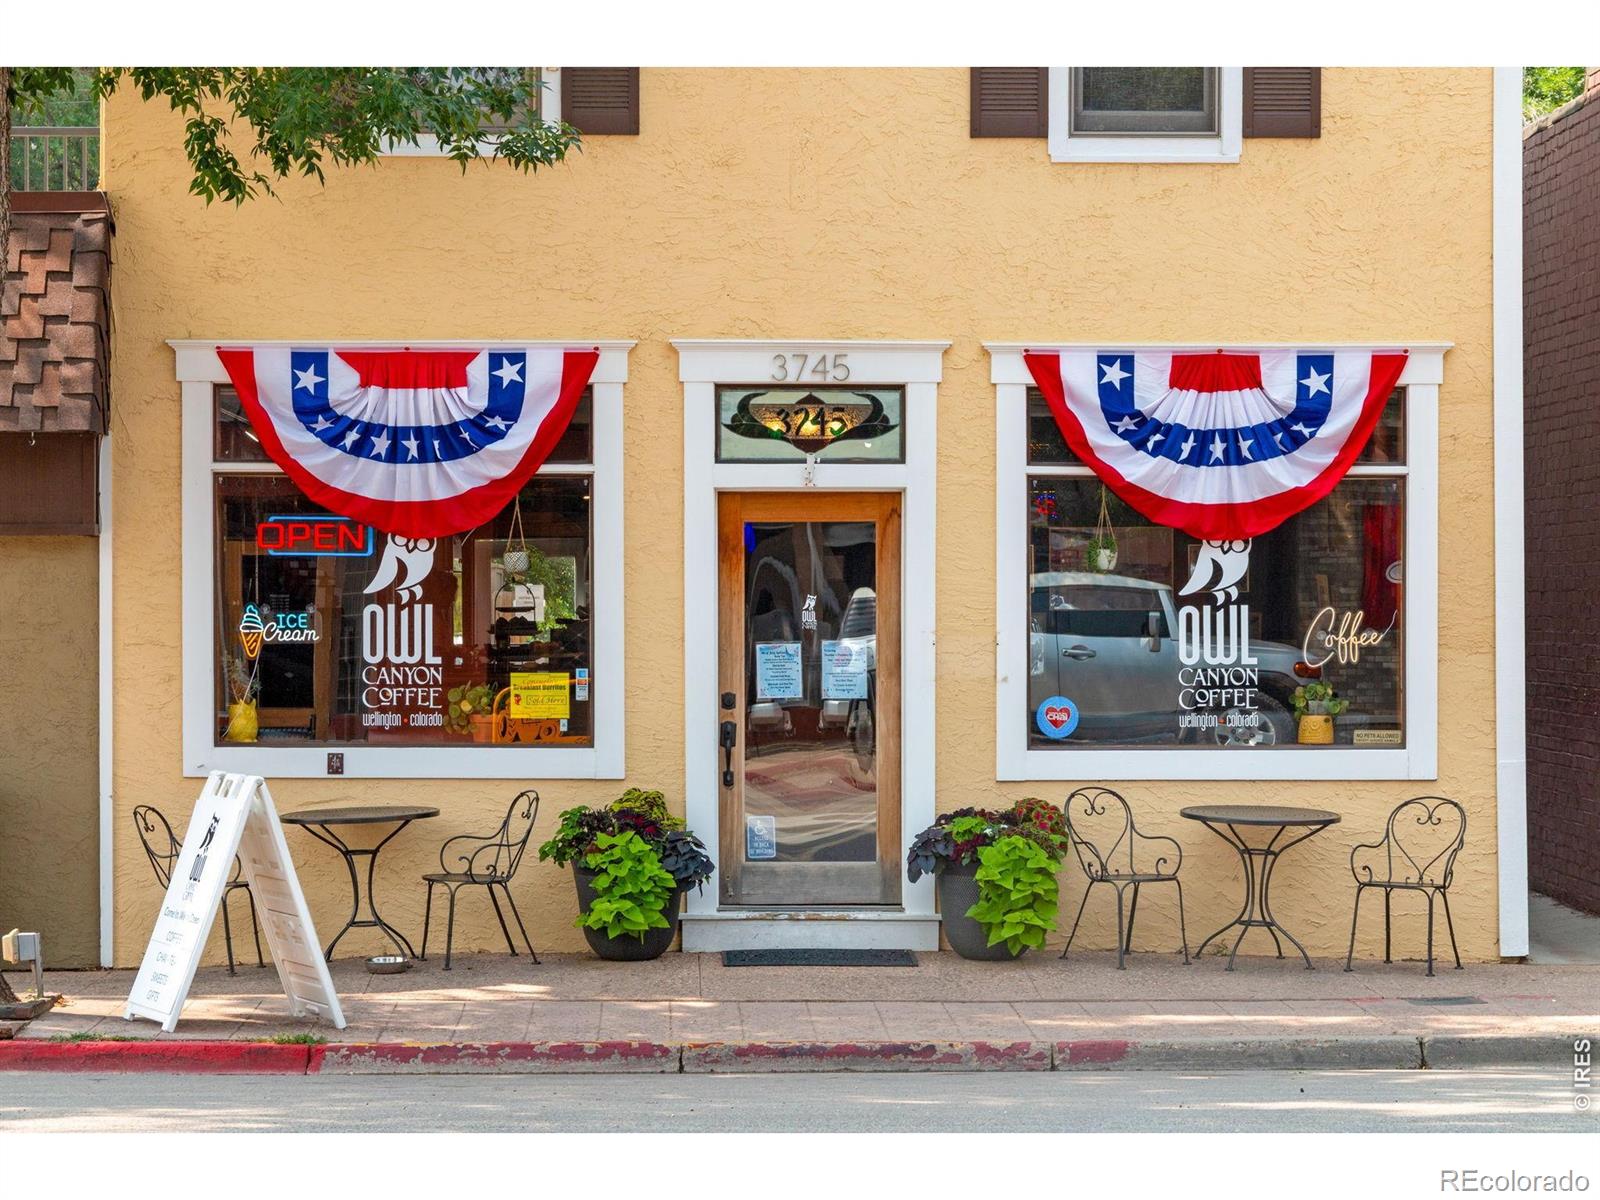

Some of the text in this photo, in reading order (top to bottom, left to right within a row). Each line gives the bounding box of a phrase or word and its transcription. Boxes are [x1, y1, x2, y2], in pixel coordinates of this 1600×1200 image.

[771, 354, 850, 381] 3745
[257, 523, 364, 549] OPEN
[276, 613, 308, 628] ICE
[263, 622, 320, 641] Cream
[362, 604, 442, 664] OWL
[1178, 605, 1258, 665] OWL
[1304, 607, 1384, 668] Coffee
[362, 666, 442, 685] CANYON
[1178, 667, 1258, 686] CANYON
[362, 687, 442, 708] COFFEE
[1178, 688, 1258, 710] COFFEE
[362, 711, 443, 730] wellington colorado
[1179, 711, 1259, 731] wellington colorado
